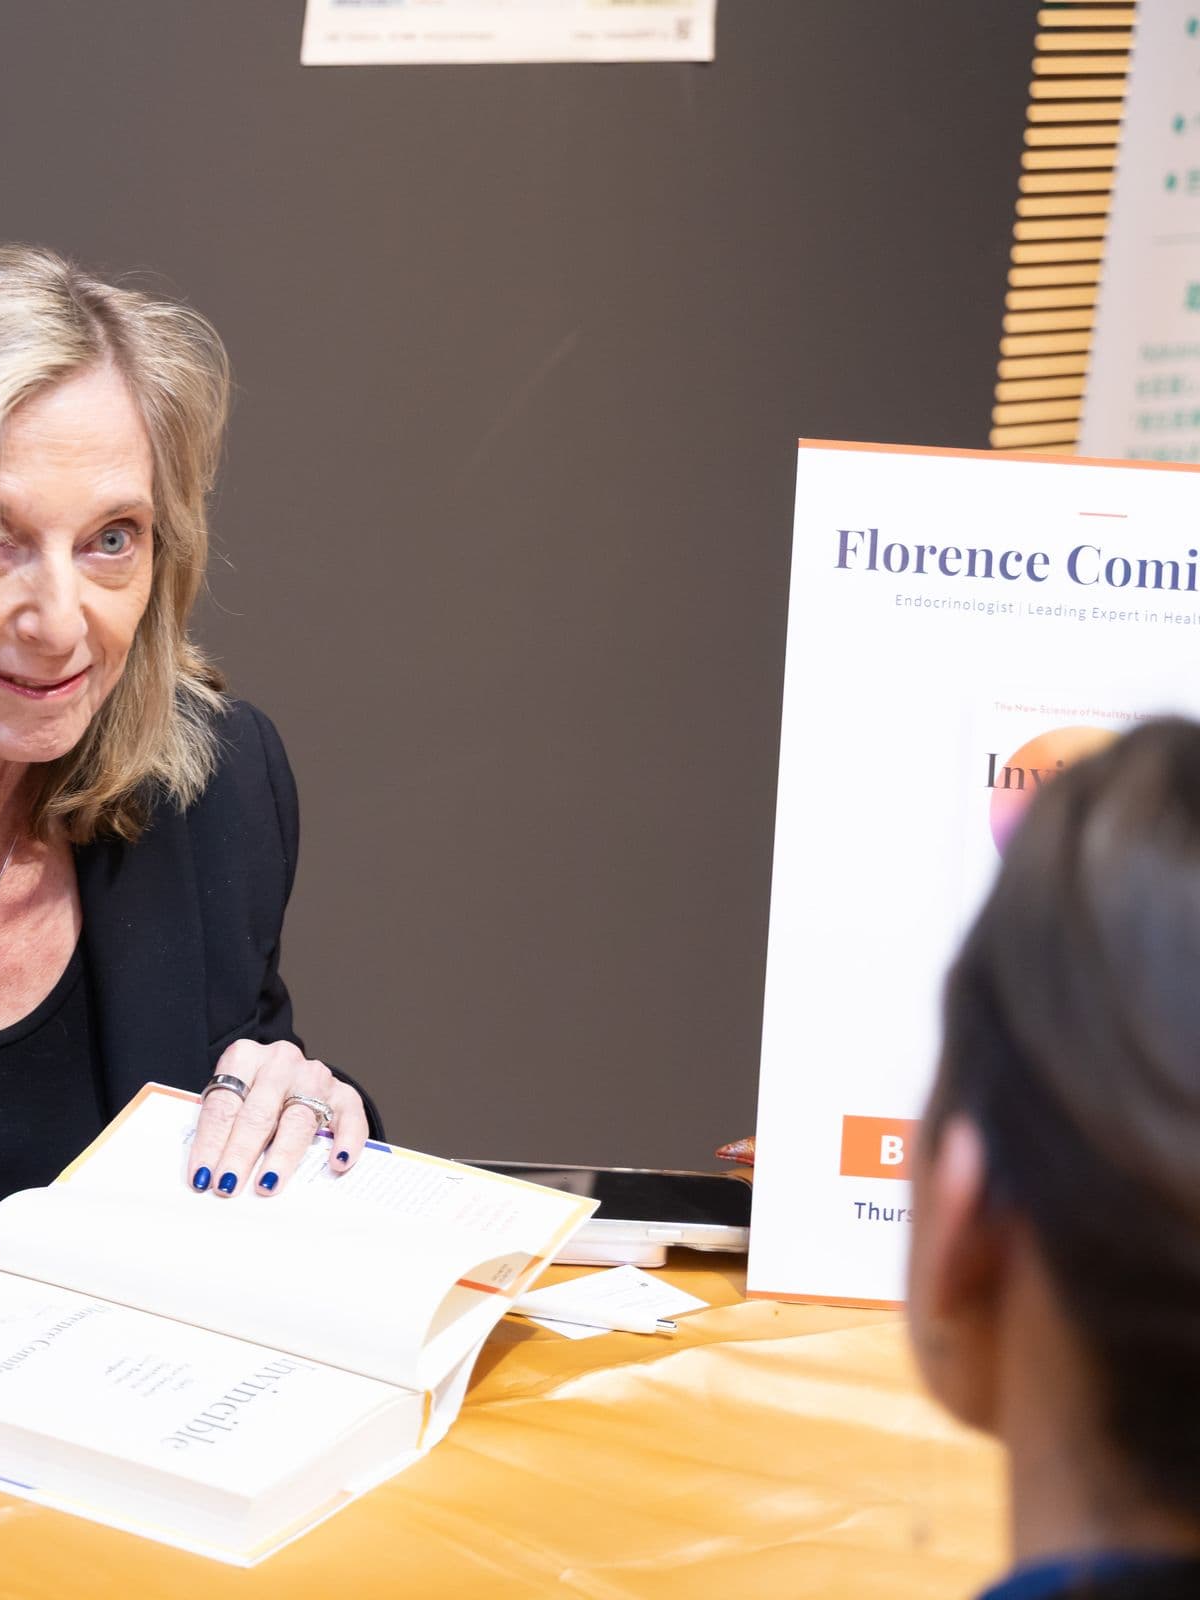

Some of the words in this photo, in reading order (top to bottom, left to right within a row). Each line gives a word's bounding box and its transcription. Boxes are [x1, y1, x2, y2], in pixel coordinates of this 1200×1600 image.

[833, 528, 1051, 582] Florence
[1066, 545, 1199, 592] Comi
[895, 594, 1014, 616] Endocrinologist
[1028, 602, 1087, 622] Leading
[1092, 607, 1140, 623] Expert
[1144, 609, 1159, 623] in
[1040, 704, 1080, 716] Science
[1092, 709, 1131, 721] Healthy
[985, 753, 1064, 790] Inv
[166, 1358, 318, 1449] Invincible
